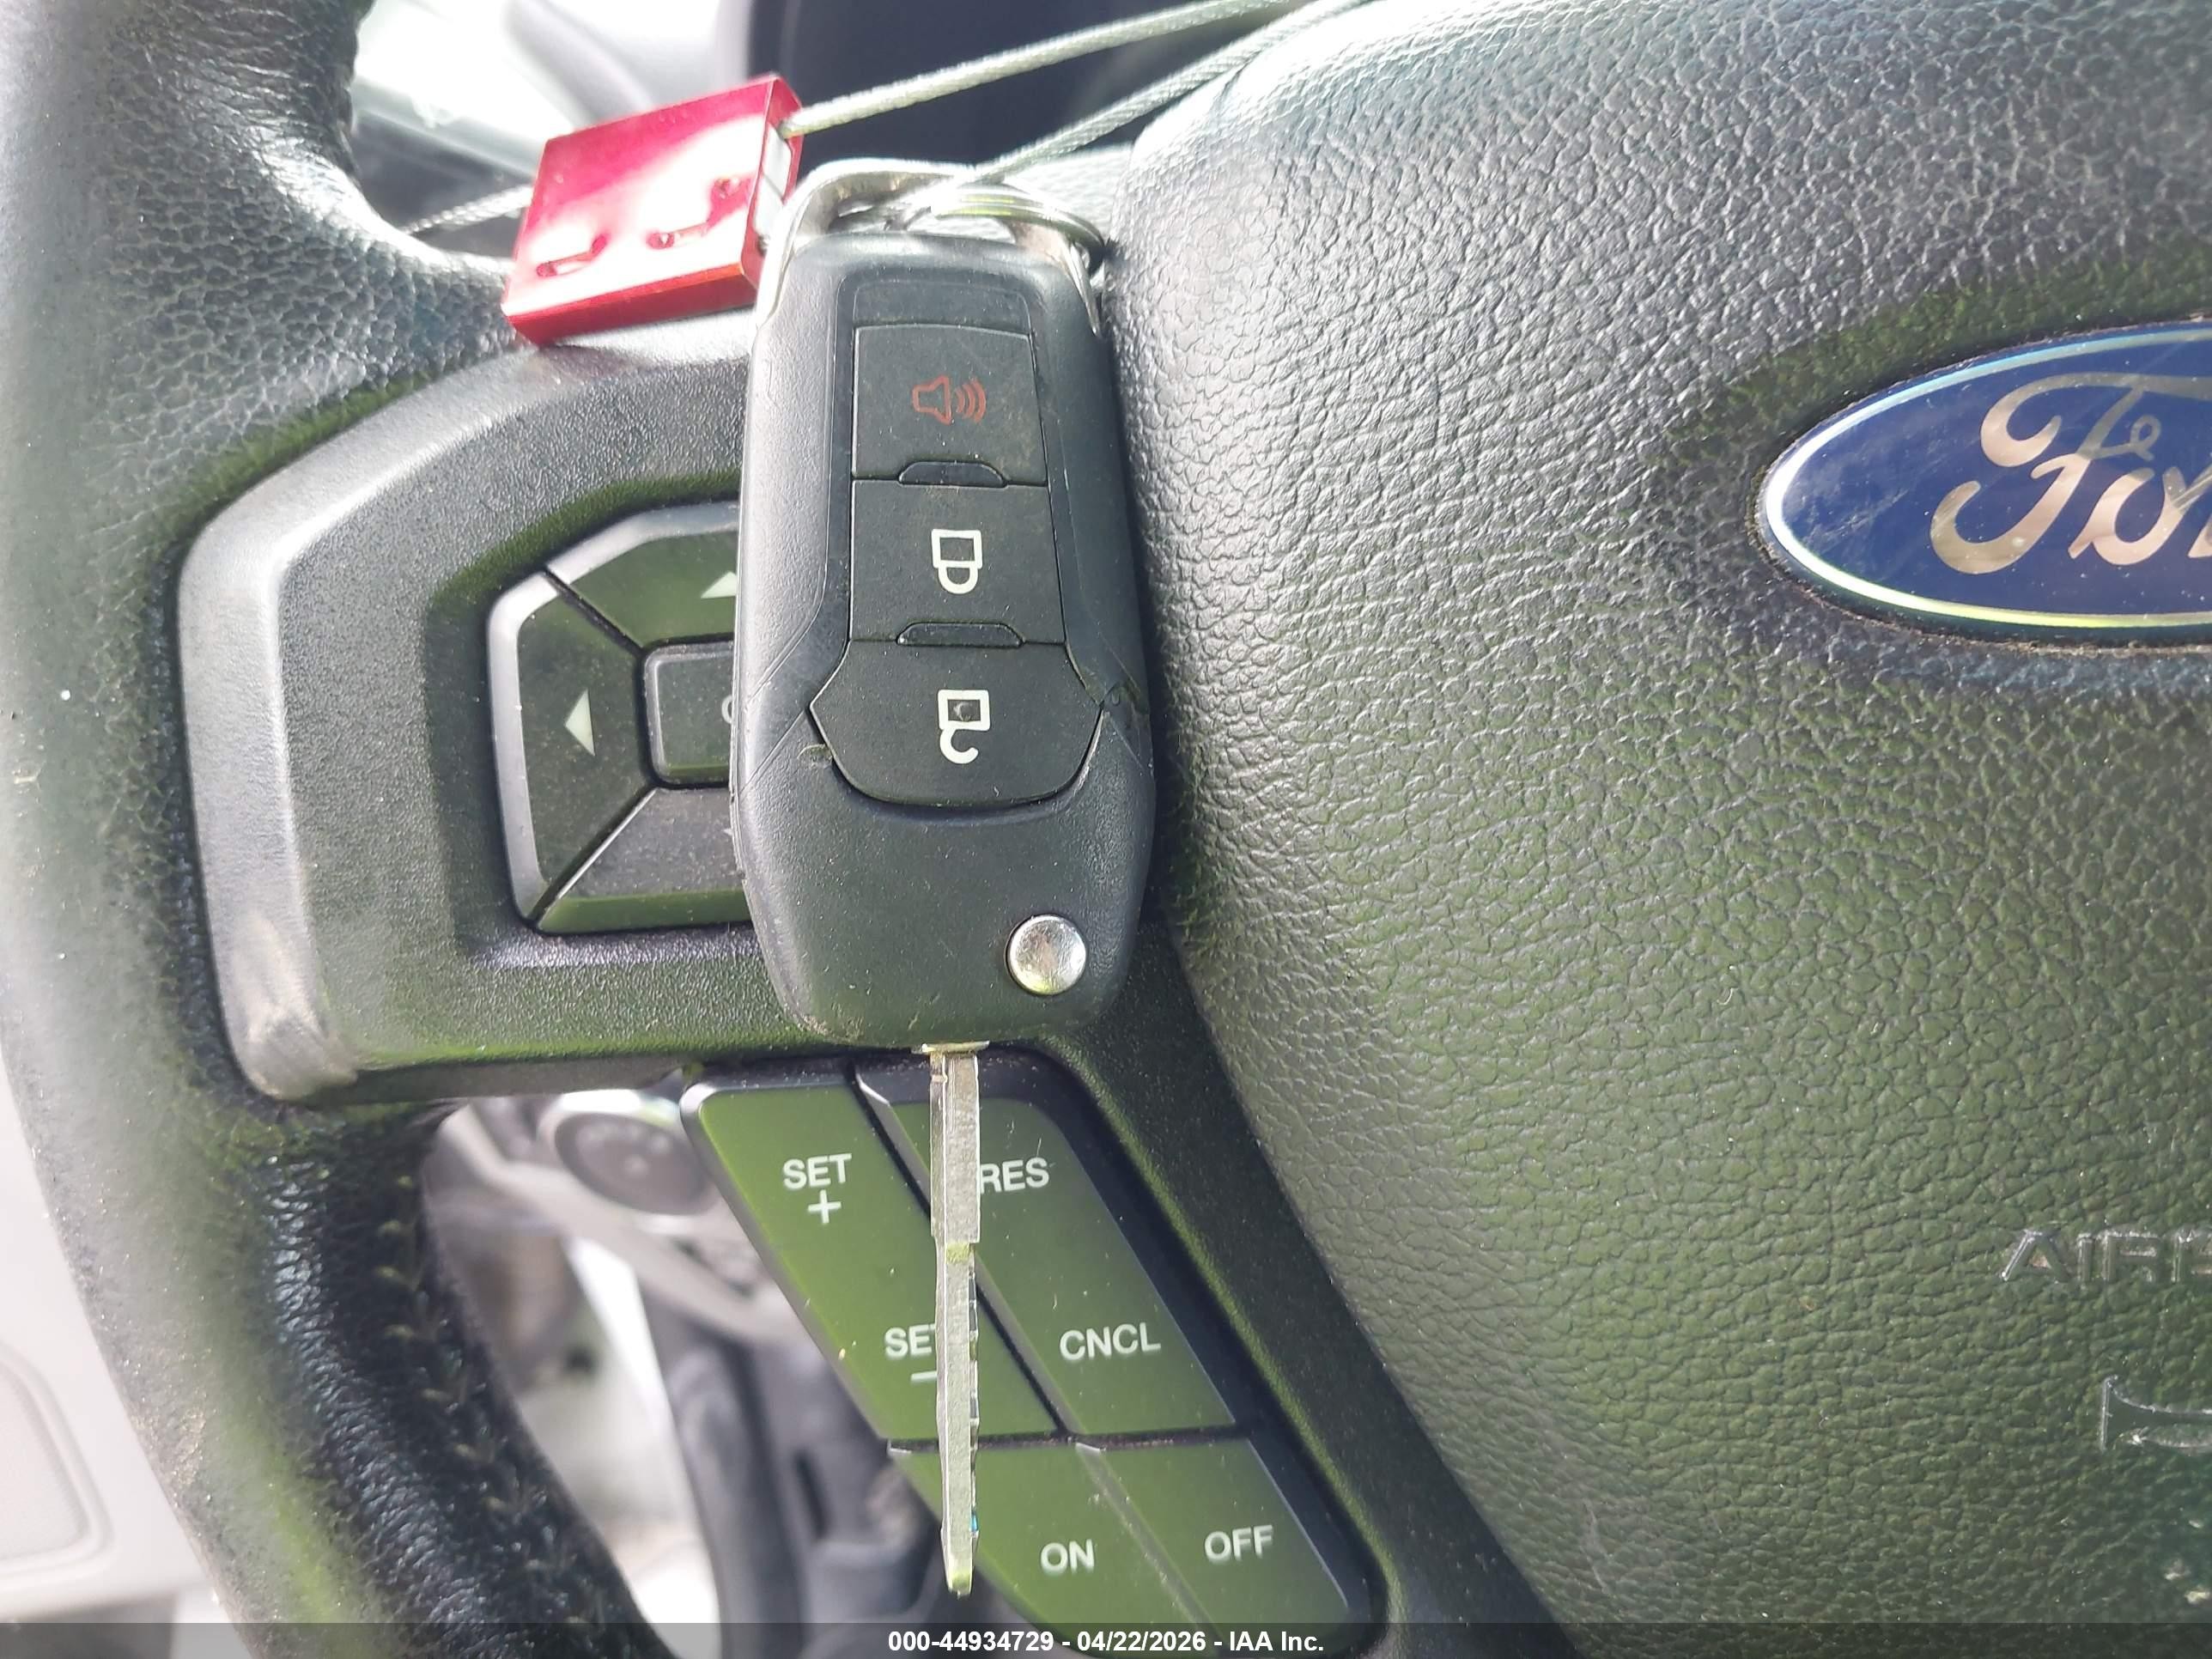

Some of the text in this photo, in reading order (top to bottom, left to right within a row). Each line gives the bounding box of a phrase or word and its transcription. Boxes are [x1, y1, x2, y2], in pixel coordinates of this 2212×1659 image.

[783, 1153, 852, 1189] SET
[979, 1157, 1049, 1194] RES
[884, 1323, 936, 1358] SE
[1060, 1322, 1161, 1360] CNCL
[1040, 1539, 1095, 1573] ON
[1204, 1525, 1273, 1562] OFF
